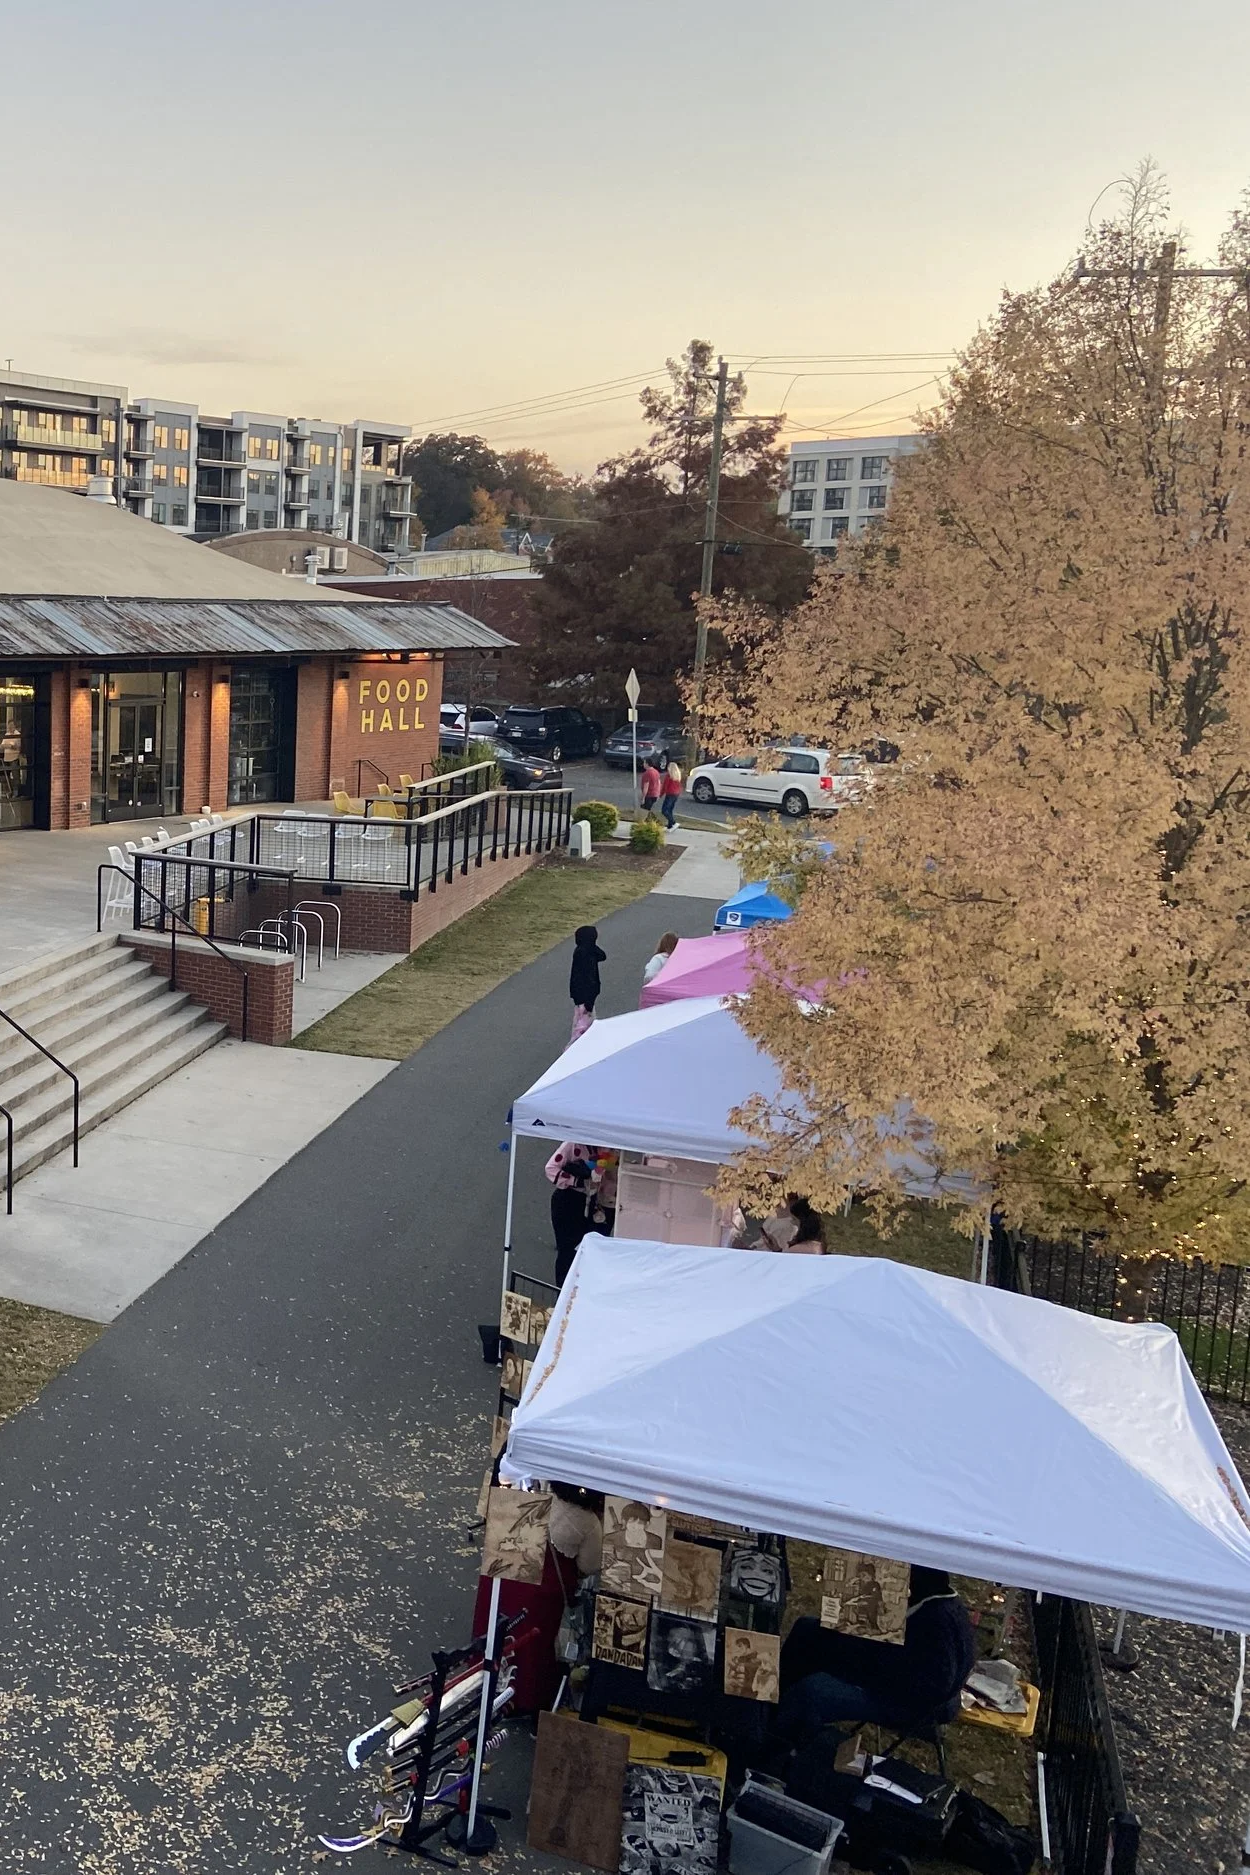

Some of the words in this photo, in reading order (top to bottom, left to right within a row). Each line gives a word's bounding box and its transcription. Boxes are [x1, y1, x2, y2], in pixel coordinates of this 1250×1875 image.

[359, 678, 429, 705] FOOD
[361, 706, 425, 733] HALL
[595, 1643, 644, 1668] DANDADAN
[645, 1794, 691, 1807] WANTED
